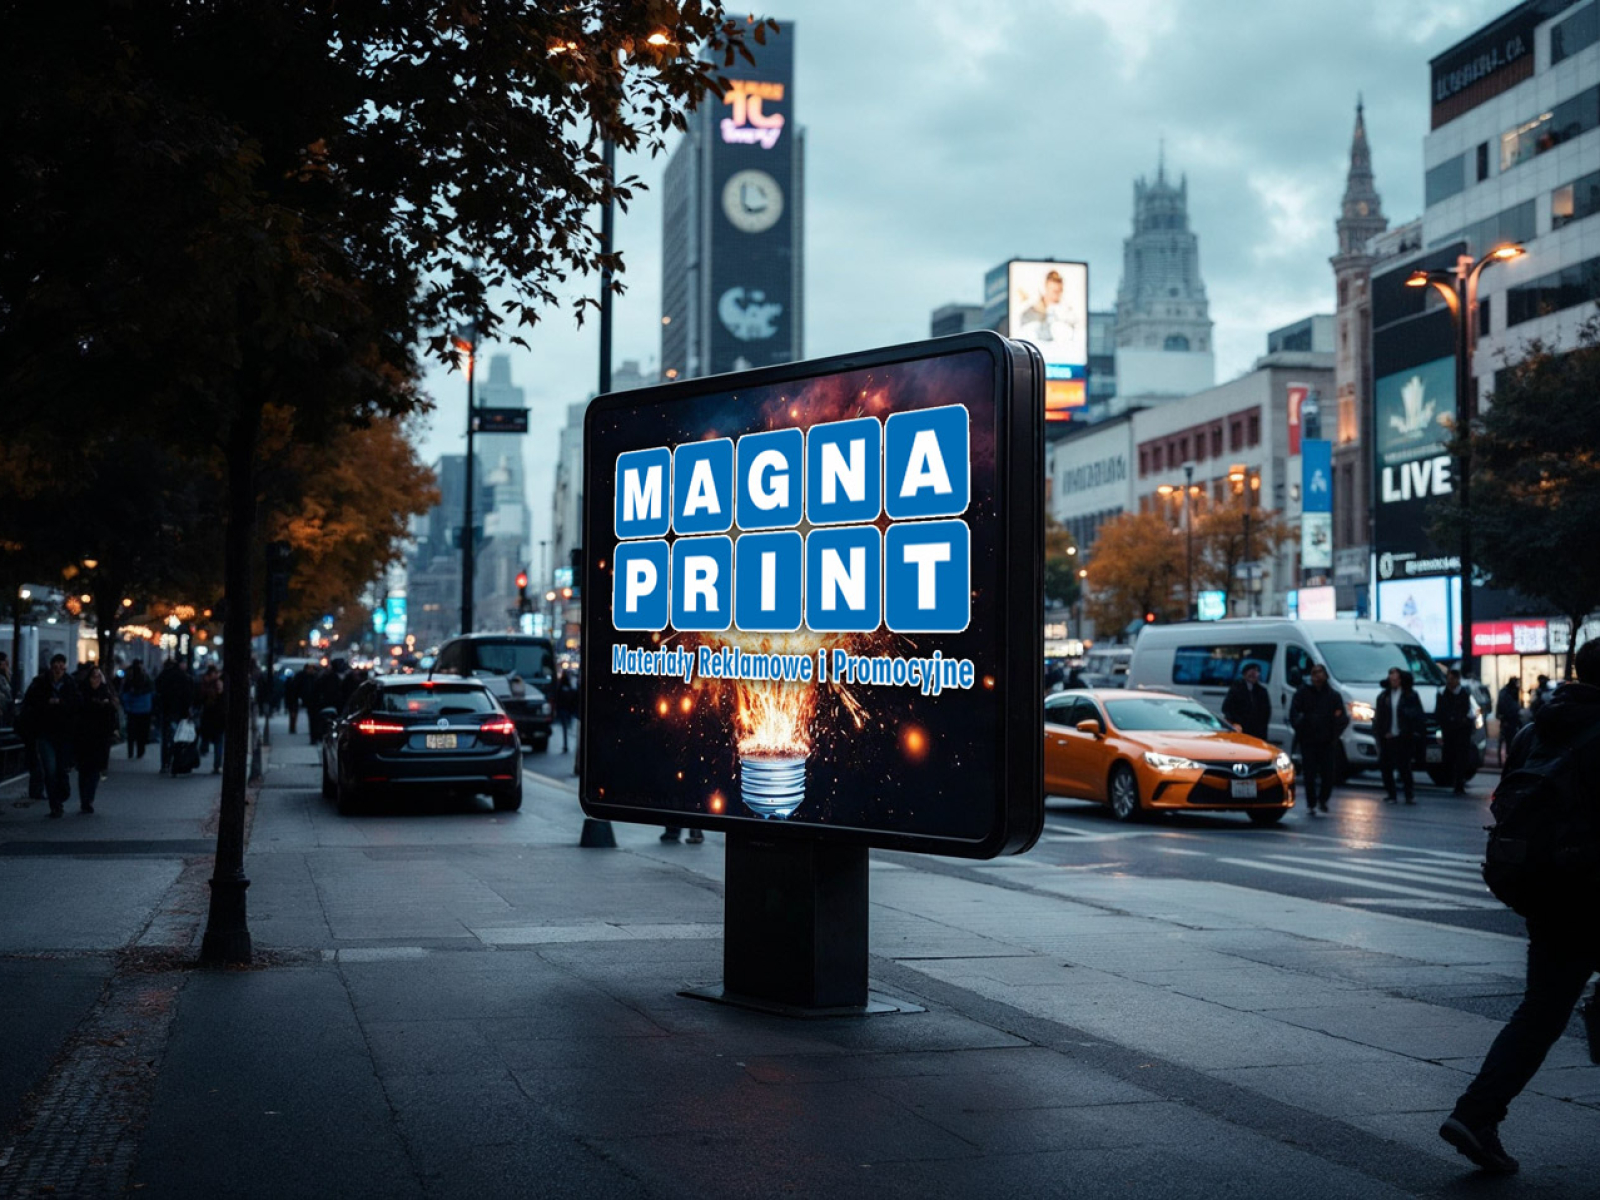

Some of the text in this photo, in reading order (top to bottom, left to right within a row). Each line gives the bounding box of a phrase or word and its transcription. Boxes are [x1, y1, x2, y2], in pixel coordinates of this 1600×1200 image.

[622, 429, 953, 522] MAGNA
[1382, 456, 1453, 502] LIVE
[624, 542, 952, 613] PRINT
[612, 644, 975, 696] Materiały Reklamowe i Promocyjne
